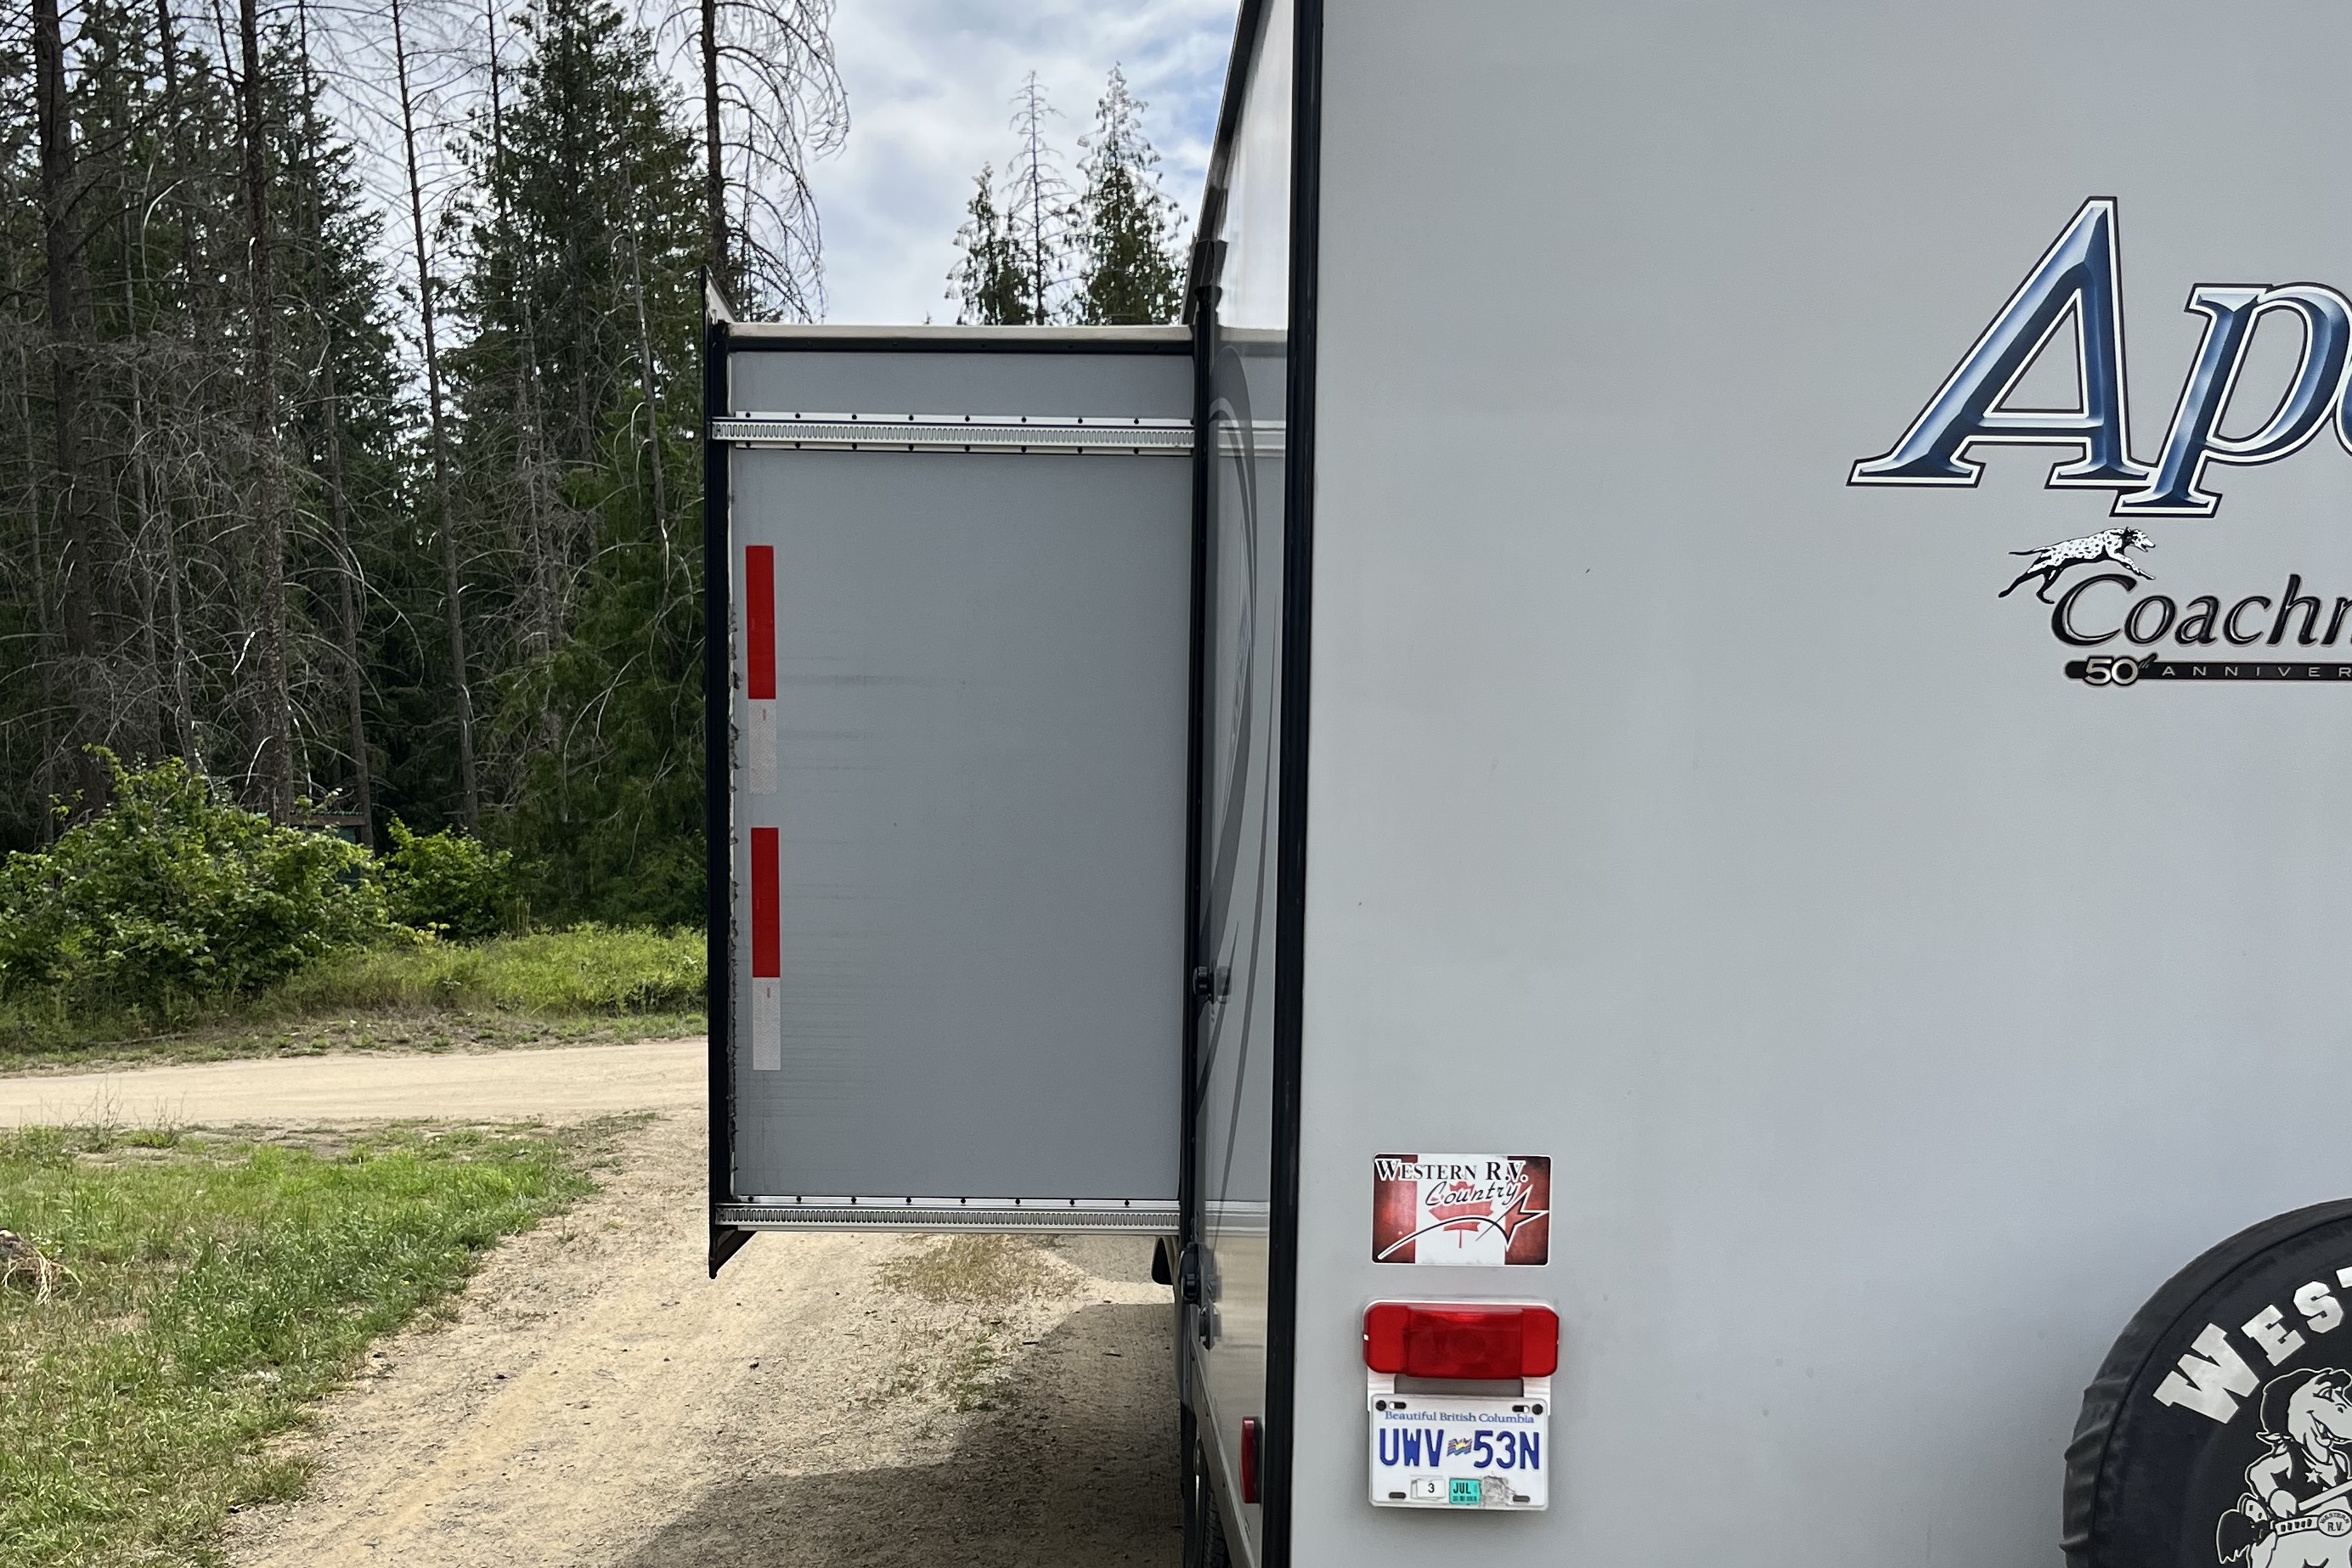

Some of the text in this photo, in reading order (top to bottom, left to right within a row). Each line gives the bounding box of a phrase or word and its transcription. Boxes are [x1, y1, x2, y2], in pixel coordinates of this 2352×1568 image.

[1847, 196, 2352, 518] Ap
[1375, 1159, 1527, 1182] WESTERN R.V.
[1424, 1181, 1520, 1206] Country
[1385, 1411, 1535, 1424] Beautiful British Columbia
[1379, 1428, 1540, 1469] UWV 53N
[1427, 1482, 1471, 1494] 3 JUL
